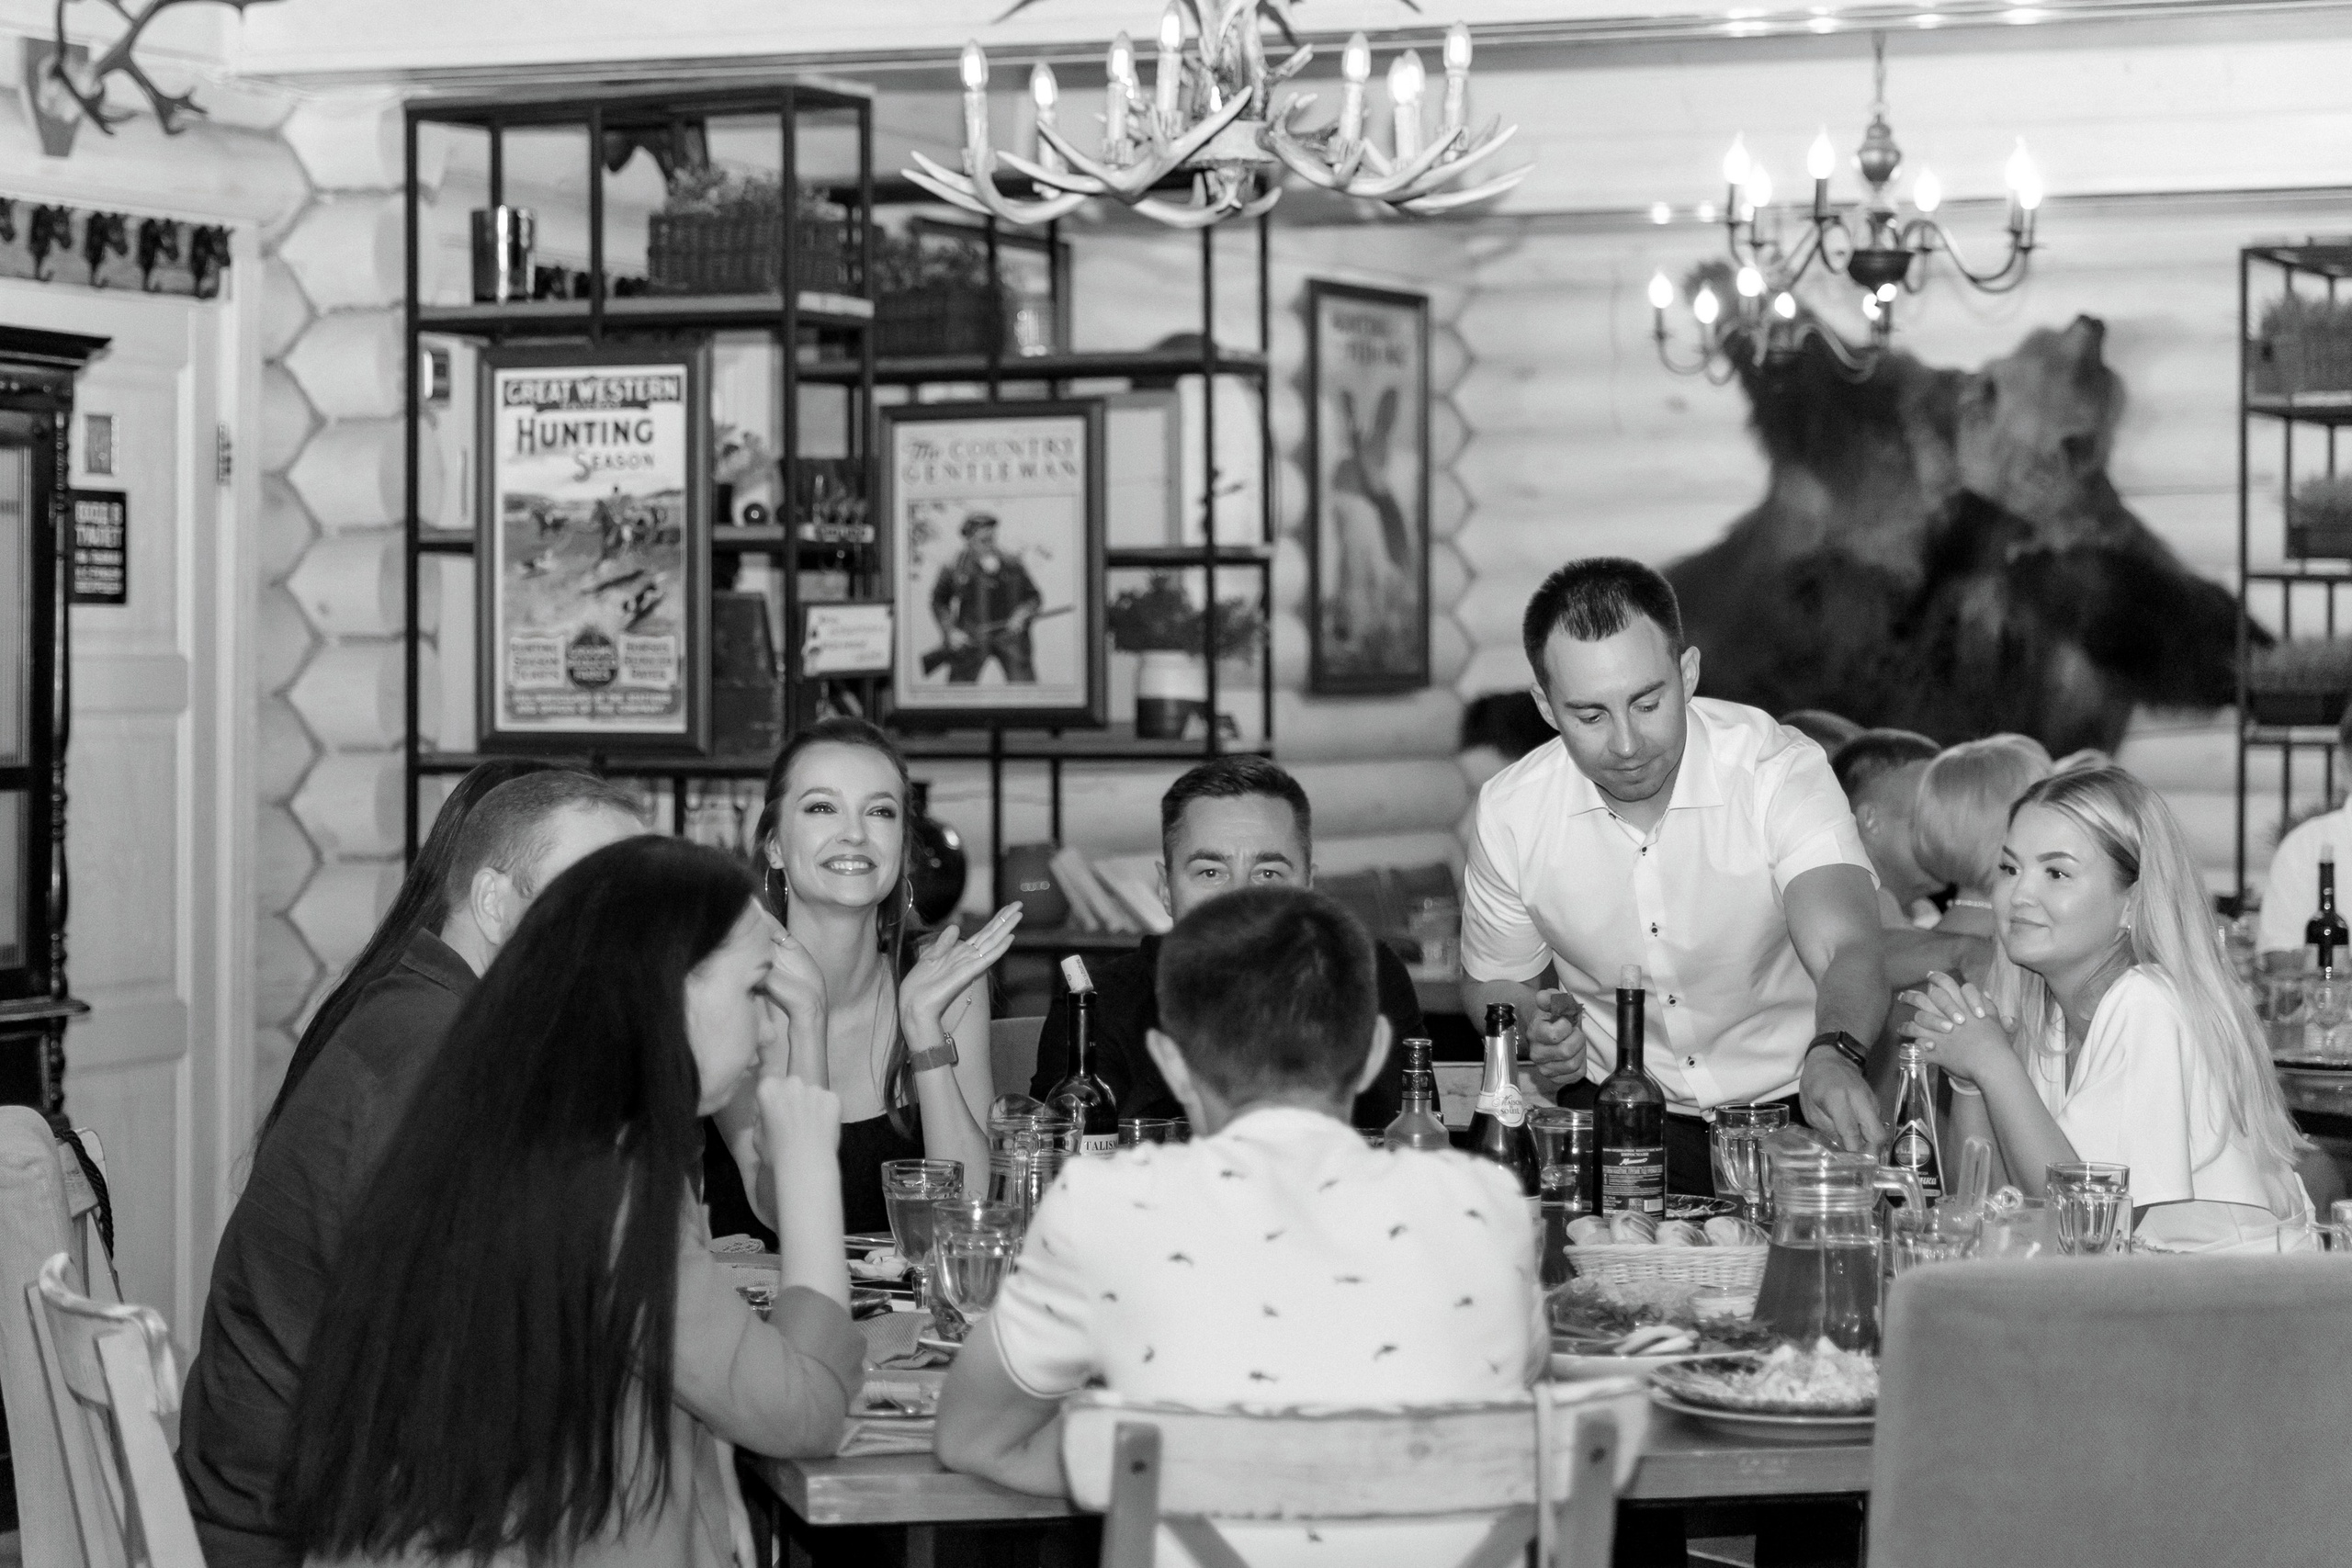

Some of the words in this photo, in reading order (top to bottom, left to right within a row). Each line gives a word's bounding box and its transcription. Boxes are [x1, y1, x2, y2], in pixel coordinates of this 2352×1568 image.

[505, 380, 571, 405] GREAT
[576, 378, 679, 402] WESTERN
[517, 417, 655, 454] HUNTING
[573, 447, 655, 482] SEASON
